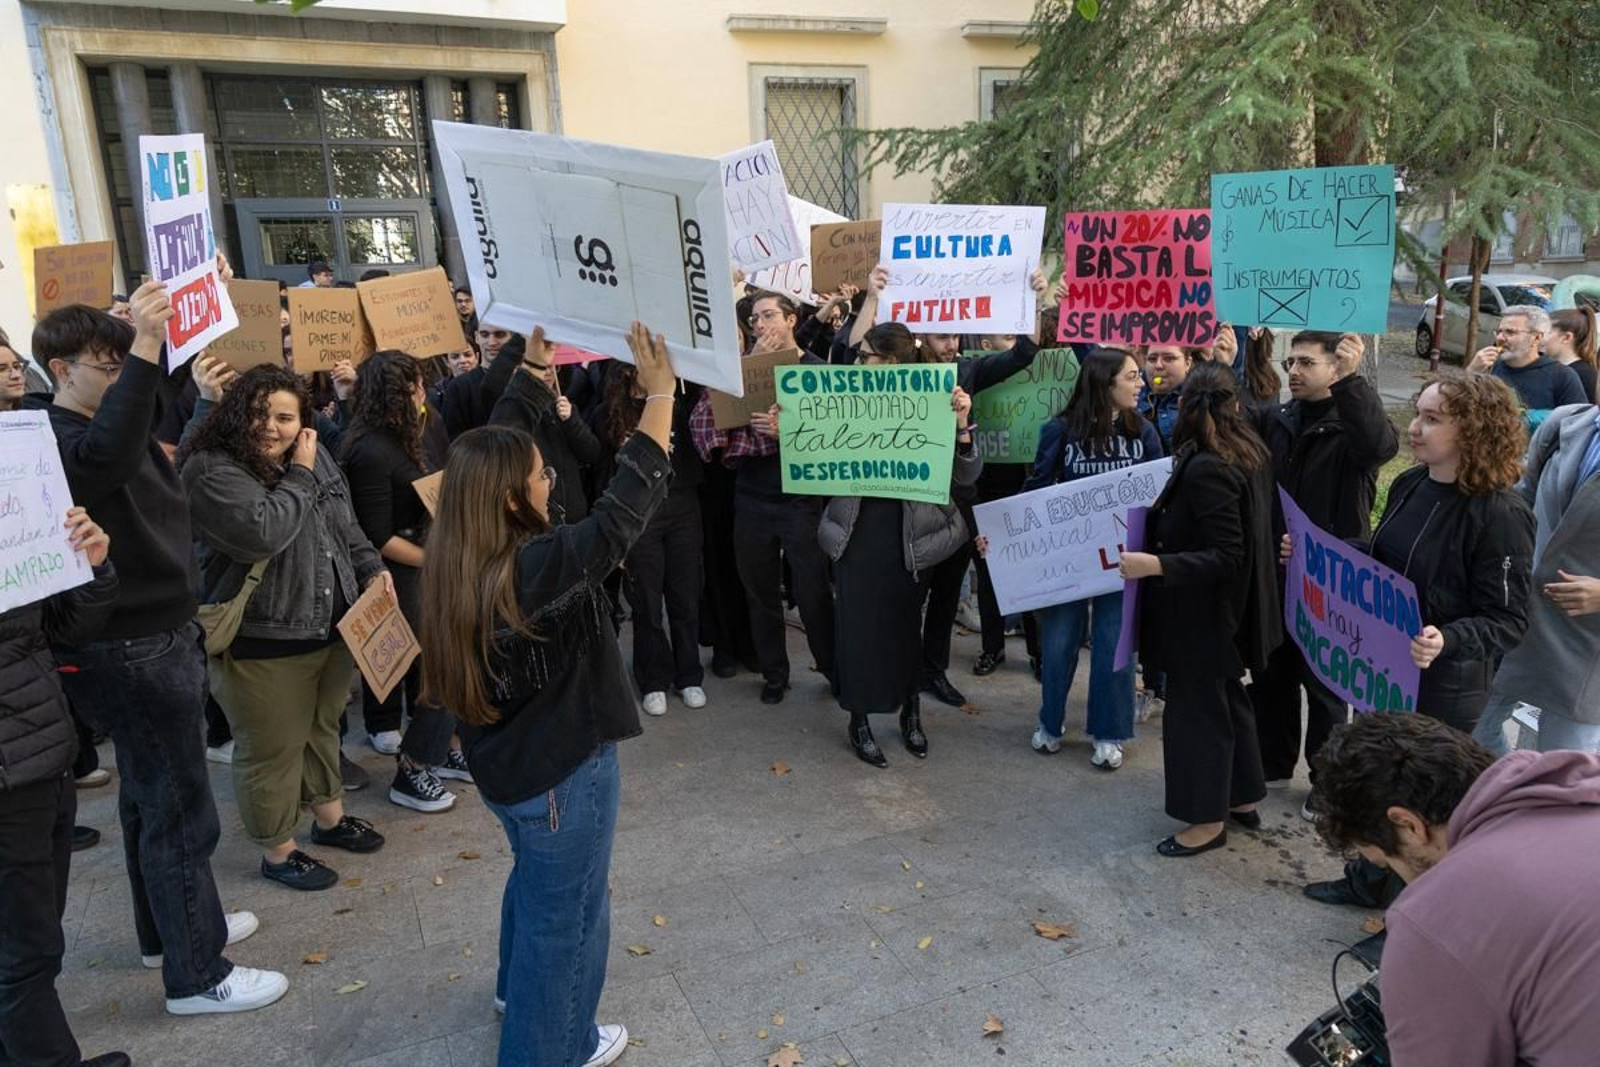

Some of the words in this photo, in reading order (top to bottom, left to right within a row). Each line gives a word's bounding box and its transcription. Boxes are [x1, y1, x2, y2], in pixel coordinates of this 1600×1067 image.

[726, 178, 775, 229] HAY
[1220, 181, 1277, 209] GANAS
[1288, 175, 1312, 201] DE
[1323, 171, 1382, 198] HACER
[1081, 214, 1116, 243] UN
[1121, 214, 1168, 244] 20%
[1173, 213, 1211, 243] NO
[892, 234, 1013, 259] CULTURA
[1185, 244, 1213, 278] L
[1222, 261, 1361, 290] INSTRUMENTOS
[891, 296, 991, 323] FUTURO
[1068, 278, 1173, 310] MÚSICA
[1178, 280, 1211, 308] NO
[309, 332, 338, 346] DAME
[1063, 311, 1096, 339] SE
[1100, 310, 1220, 345] IMPROVIS
[780, 369, 956, 394] CONSERVATORIO
[799, 394, 929, 420] ABANDONADO
[785, 421, 947, 452] talento
[789, 461, 930, 481] DESPERDICIADO
[1003, 507, 1042, 537] LA
[1000, 518, 1099, 563] musical
[0, 552, 64, 592] AMPADO
[1328, 595, 1363, 656] hay
